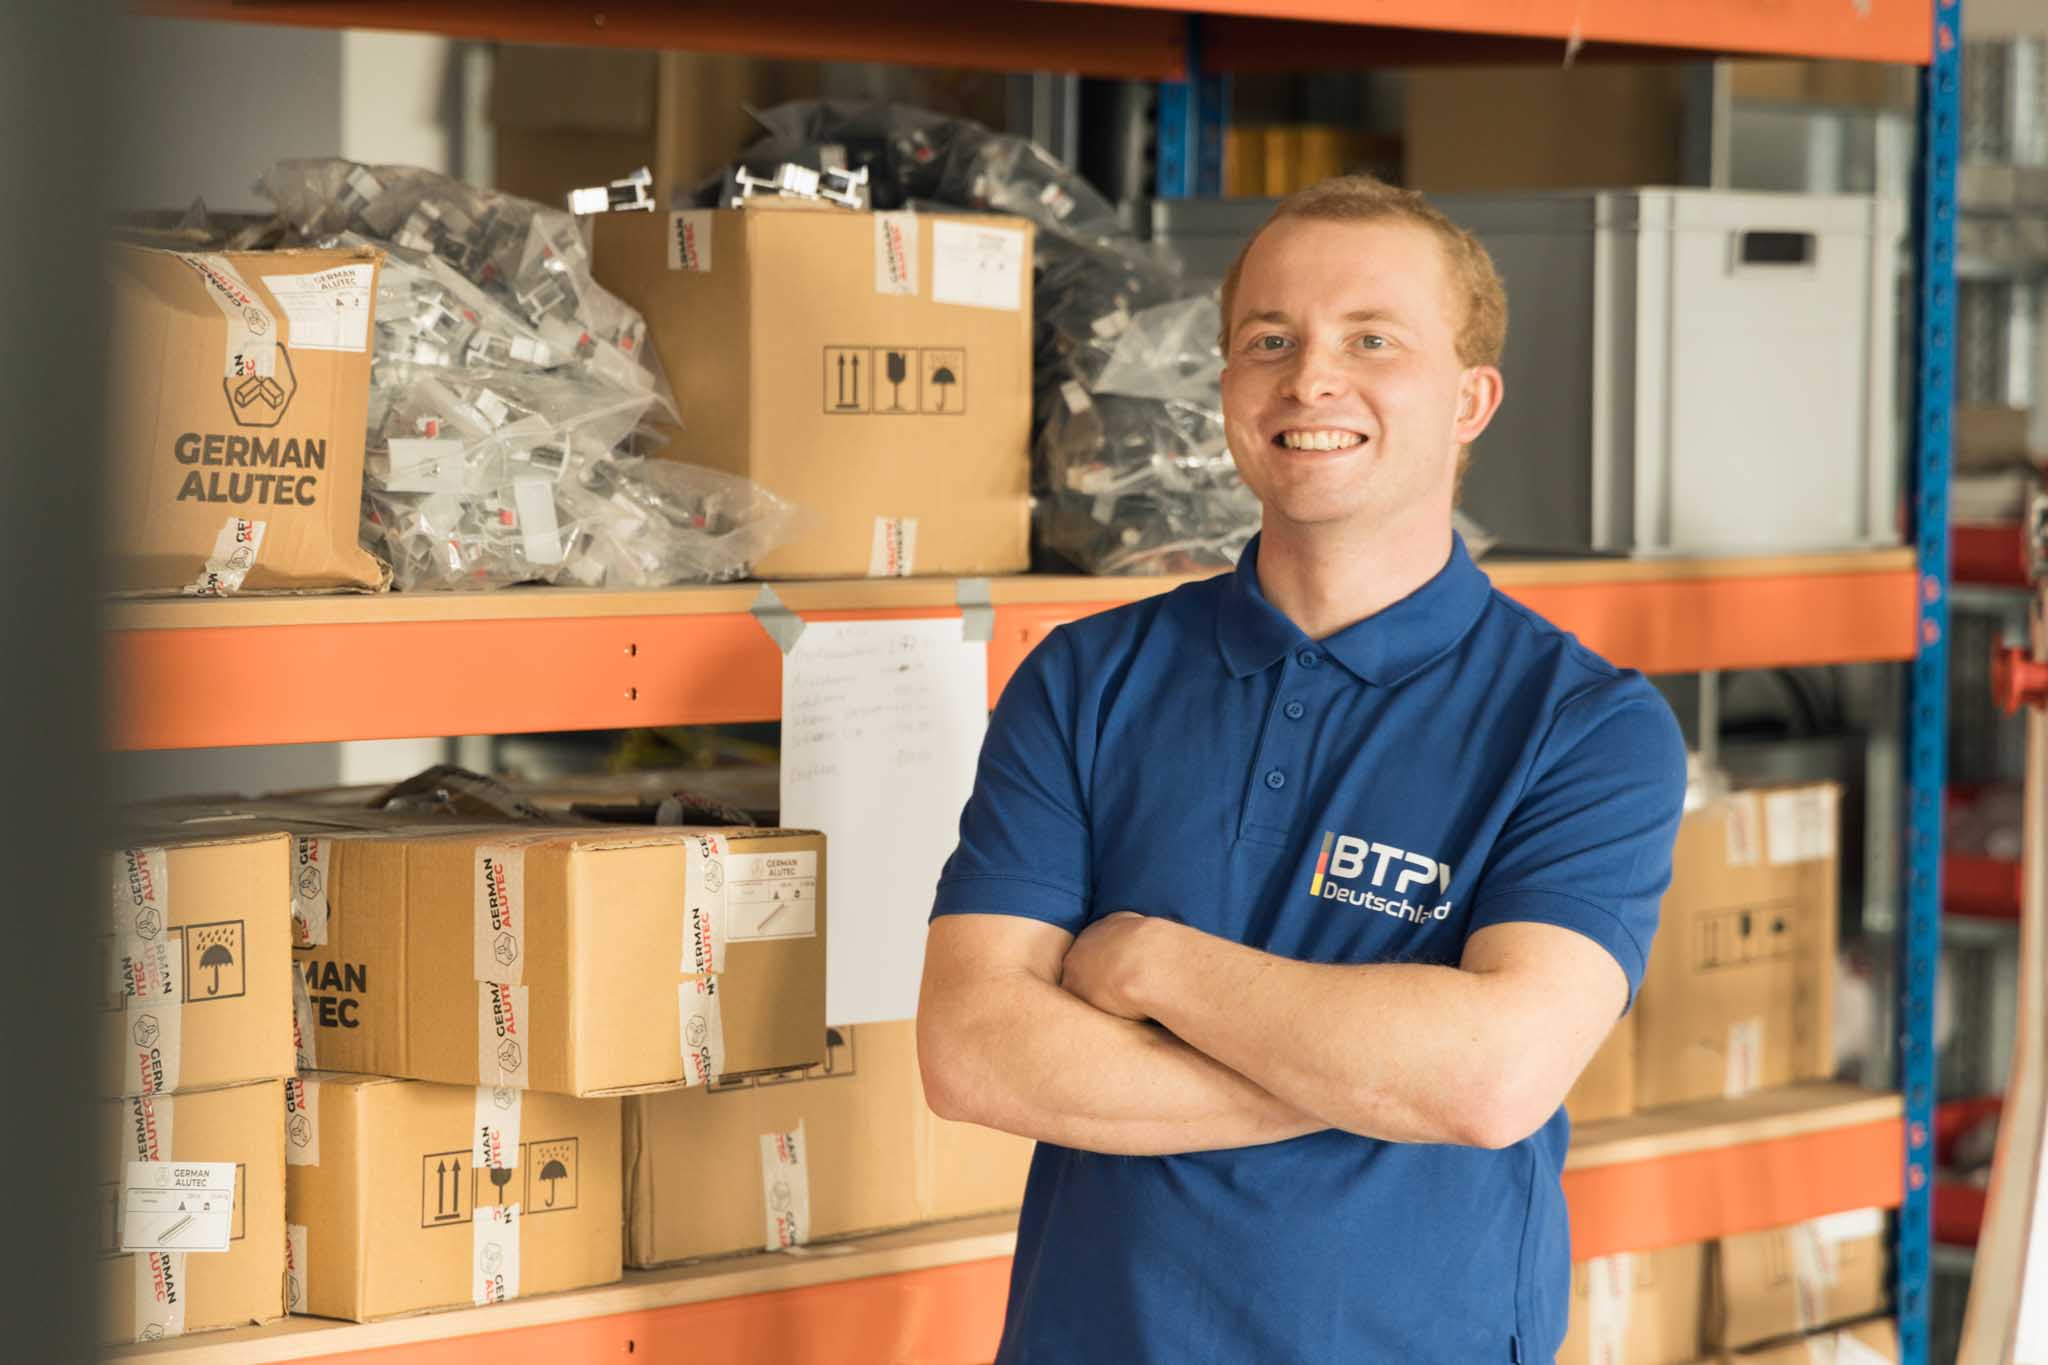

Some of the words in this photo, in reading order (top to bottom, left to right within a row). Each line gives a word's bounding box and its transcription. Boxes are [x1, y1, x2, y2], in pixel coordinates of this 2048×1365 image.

[174, 432, 326, 470] GERMAN
[176, 470, 317, 506] ALUTEC
[483, 858, 502, 931] GERMAN
[494, 863, 512, 928] ALUTEC
[701, 911, 713, 973] ALUTEC
[174, 1168, 210, 1177] GERMAN
[175, 1179, 207, 1187] ALUTEC
[159, 1252, 177, 1304] RMAN
